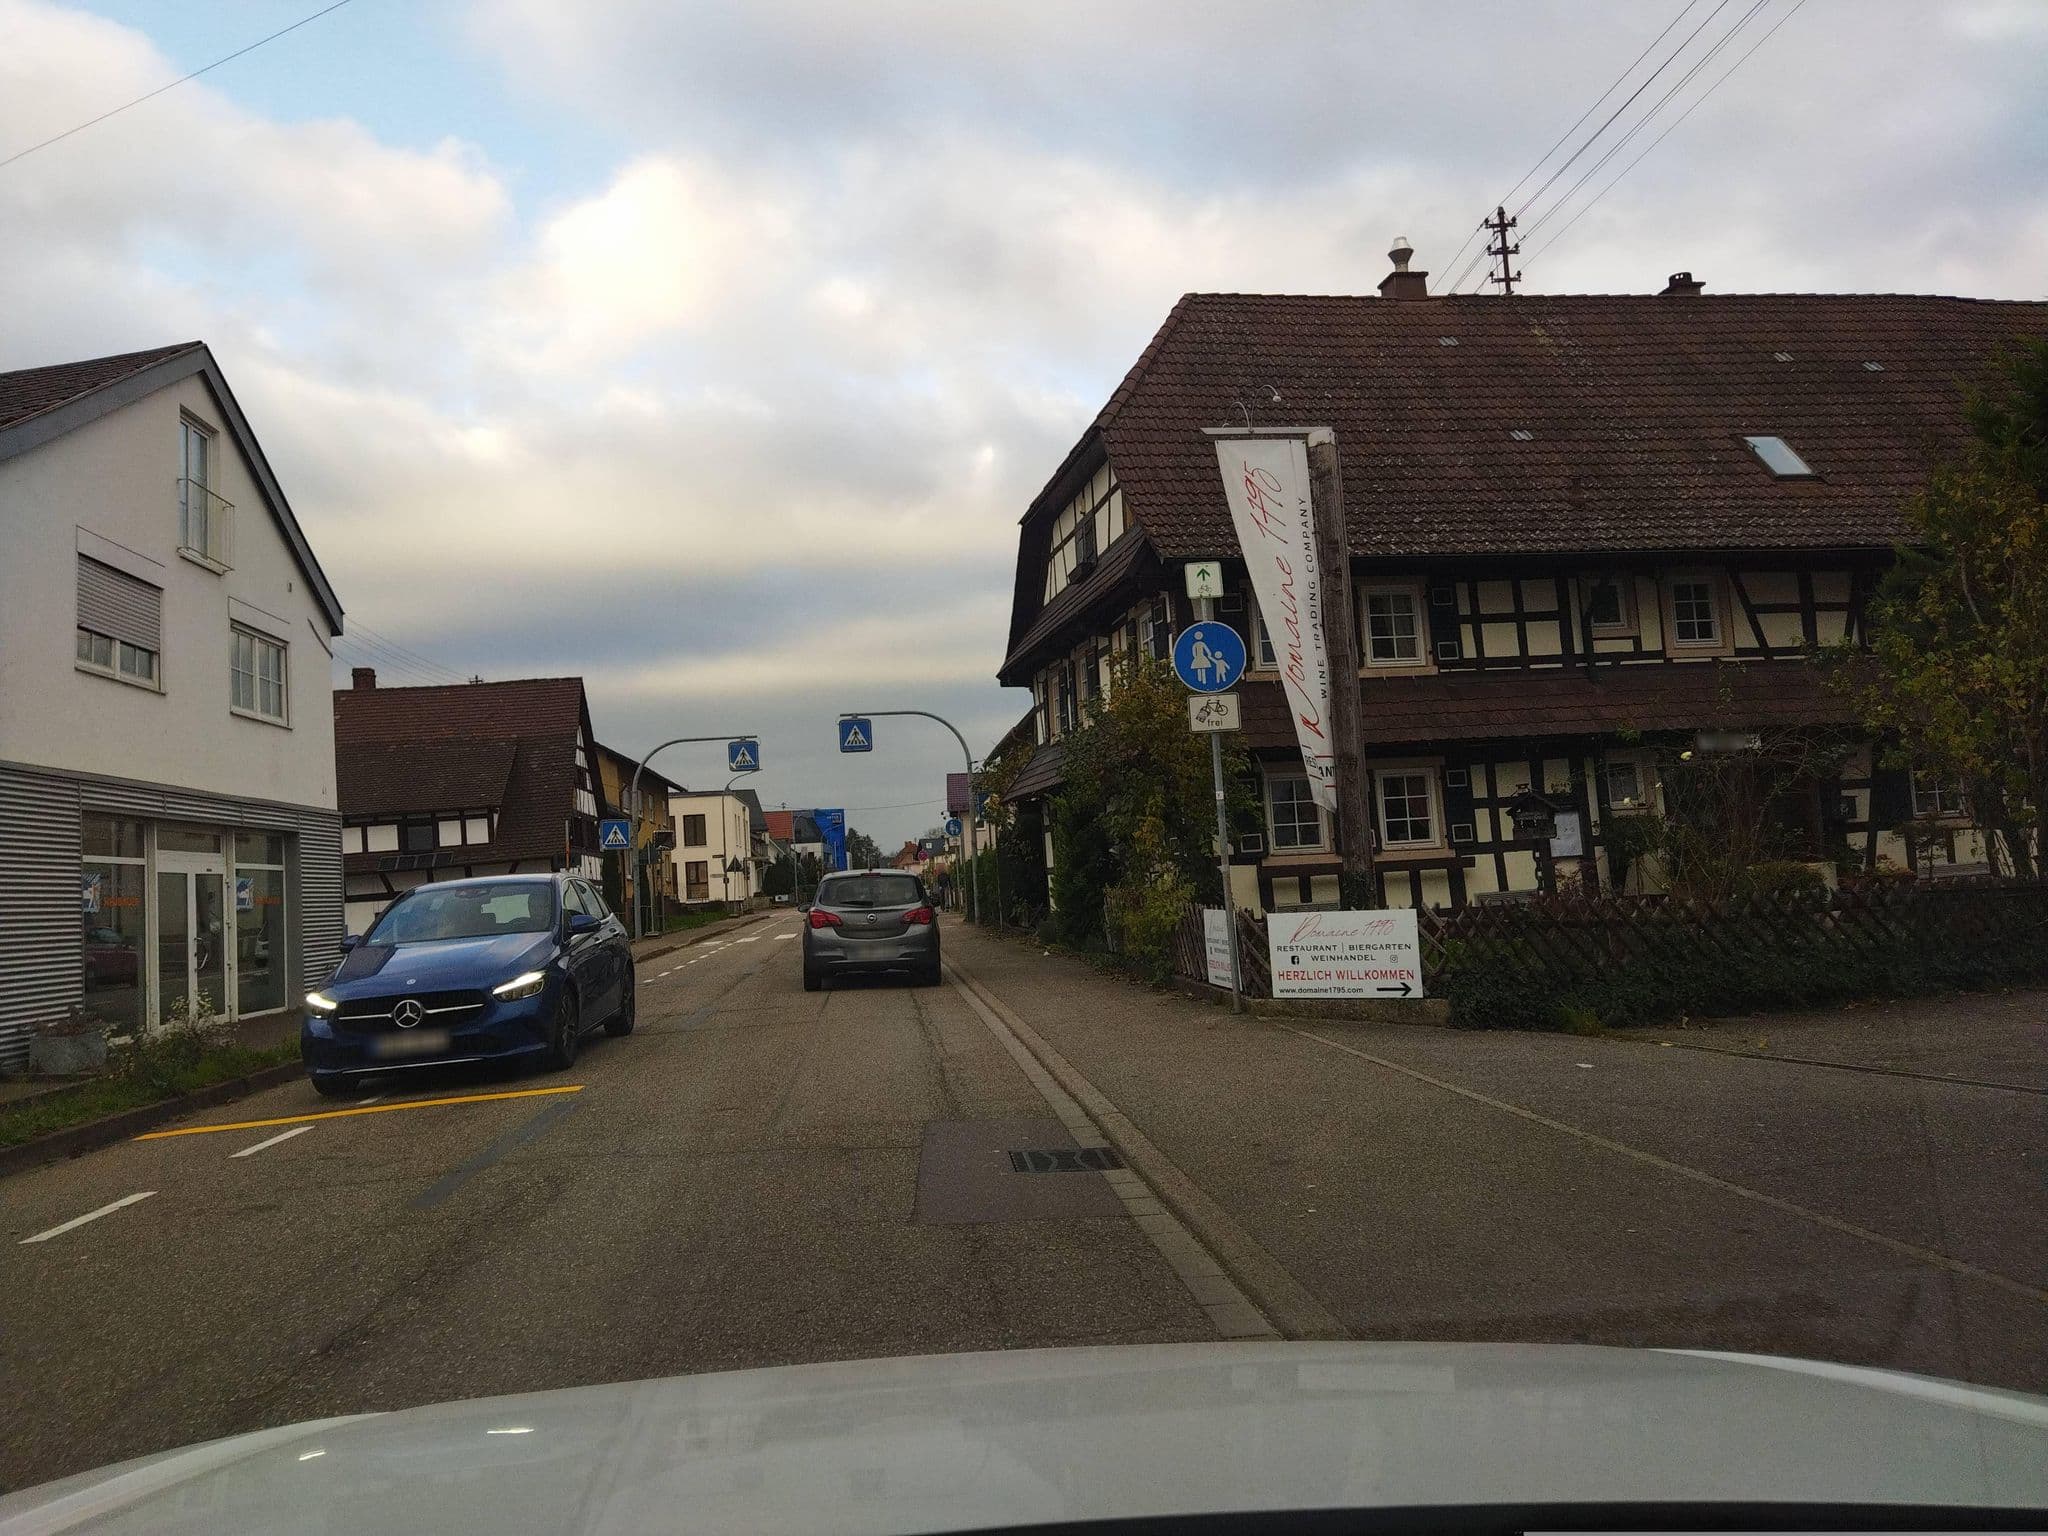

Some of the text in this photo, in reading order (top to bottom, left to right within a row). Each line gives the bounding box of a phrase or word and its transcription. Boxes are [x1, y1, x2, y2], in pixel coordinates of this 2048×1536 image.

[1243, 461, 1289, 545] 1795
[1298, 498, 1329, 699] WINE TRADING COMPANY
[1207, 718, 1223, 727] frei
[1290, 914, 1397, 944] Domaine 1795
[1276, 943, 1412, 952] RESTAURANT BIERGARTEN
[1310, 954, 1377, 962] WEINHANDEL
[1278, 969, 1414, 981] HERZLICH WILLKOMMEN
[1278, 986, 1364, 994] www.domaine1795.com
